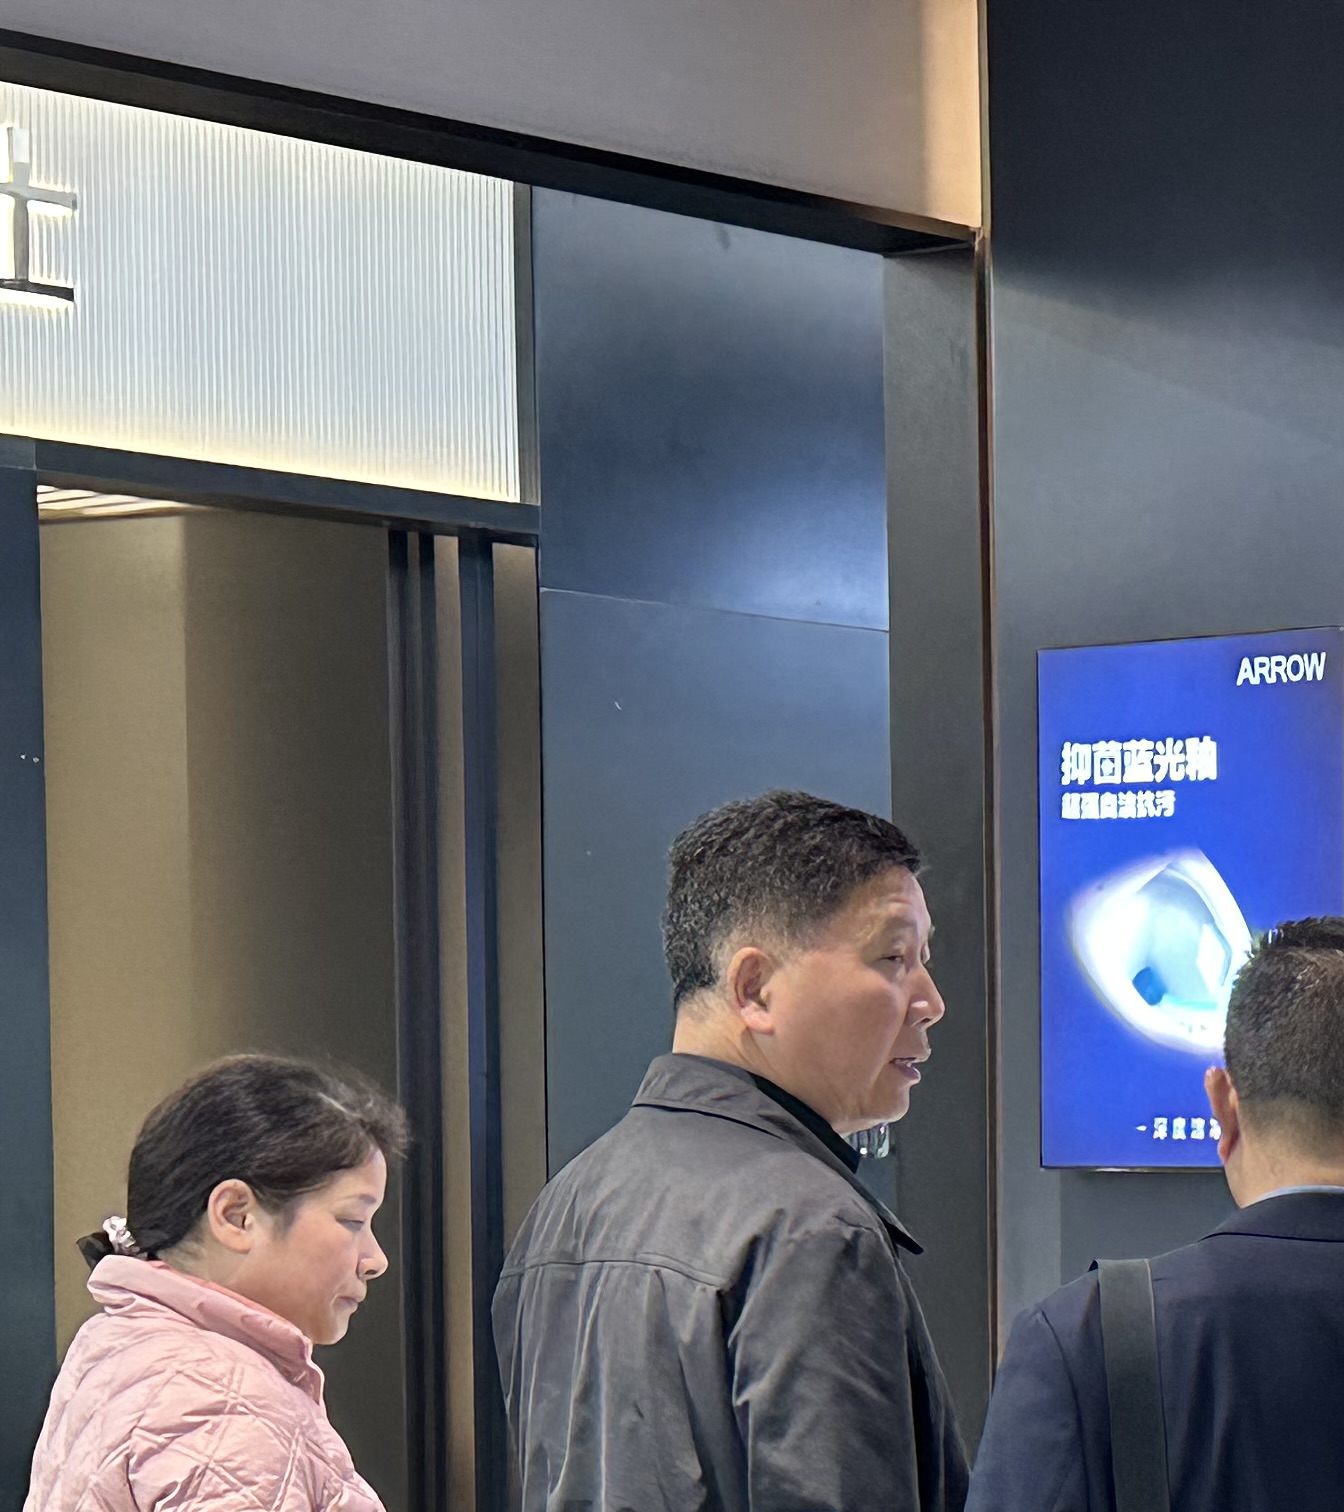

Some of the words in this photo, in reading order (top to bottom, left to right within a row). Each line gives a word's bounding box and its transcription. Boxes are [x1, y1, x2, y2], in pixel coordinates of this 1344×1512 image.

[1236, 652, 1326, 686] ARROW
[1061, 736, 1217, 785] 抑菌蓝光釉
